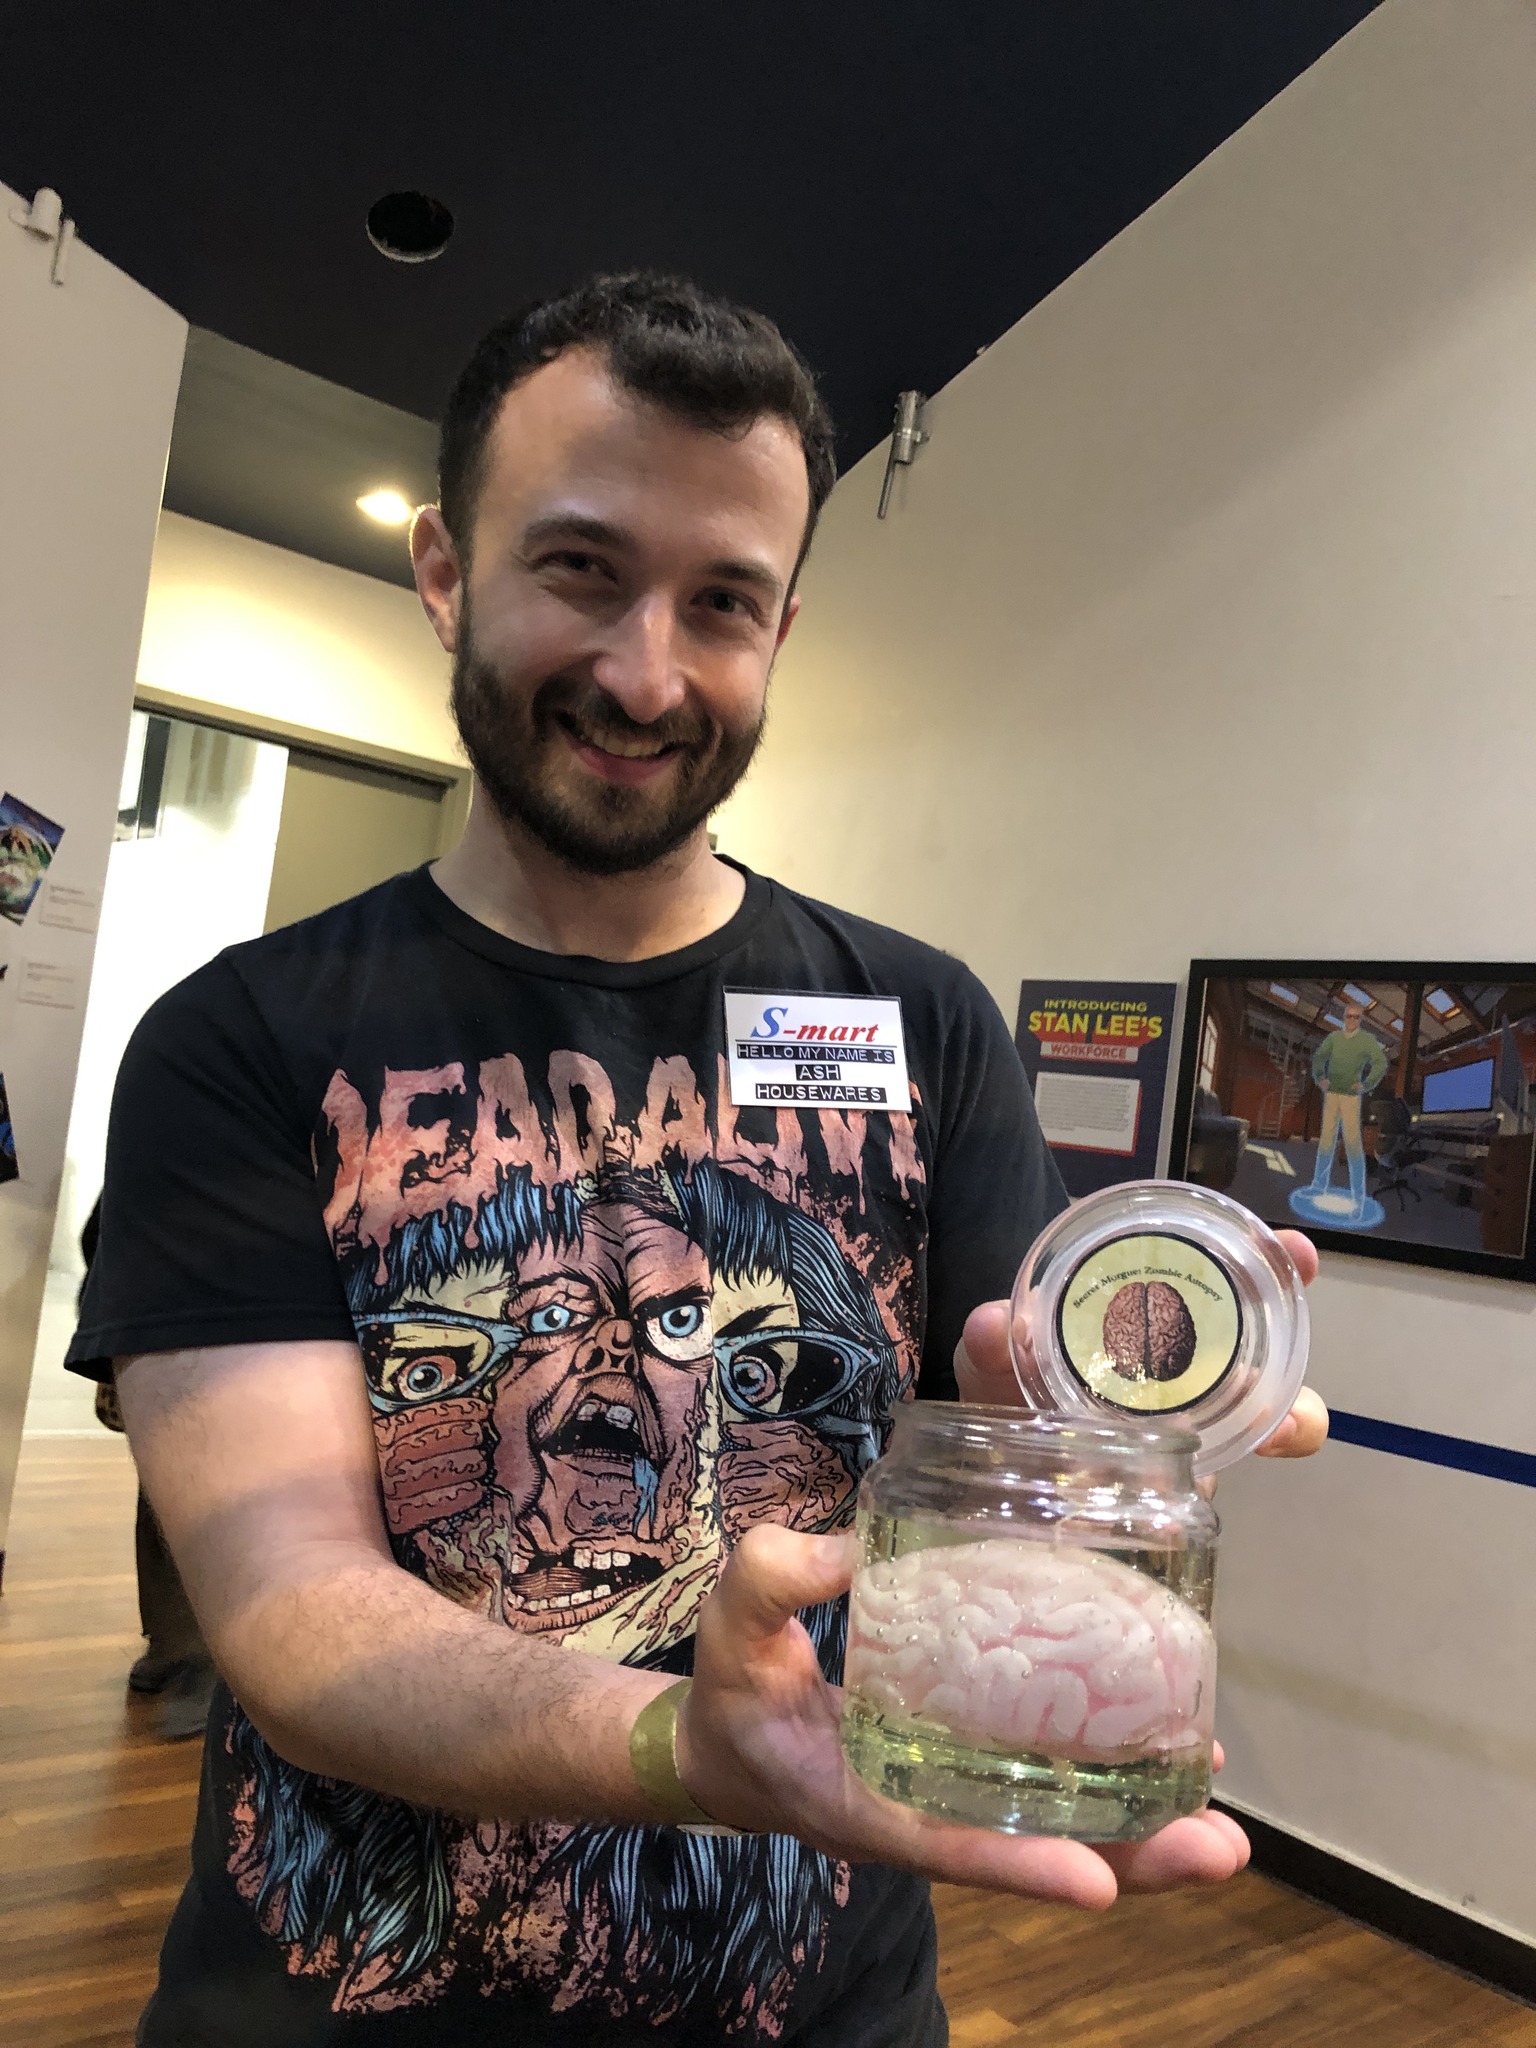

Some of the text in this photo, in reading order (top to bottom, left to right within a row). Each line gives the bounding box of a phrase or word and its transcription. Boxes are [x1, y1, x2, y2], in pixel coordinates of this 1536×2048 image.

[1044, 999, 1147, 1012] INTRODUCING
[751, 1007, 879, 1042] S-mart
[1028, 1011, 1163, 1039] STAN LEE'S
[737, 1046, 894, 1063] HELLO MY NAME IS
[1051, 1043, 1126, 1059] WORKFORCE
[799, 1064, 840, 1080] ASH
[756, 1085, 881, 1101] HOUSEWARES
[1073, 1284, 1100, 1309] Secret
[1145, 1266, 1182, 1278] Zombie
[1184, 1273, 1223, 1302] Autopsy
